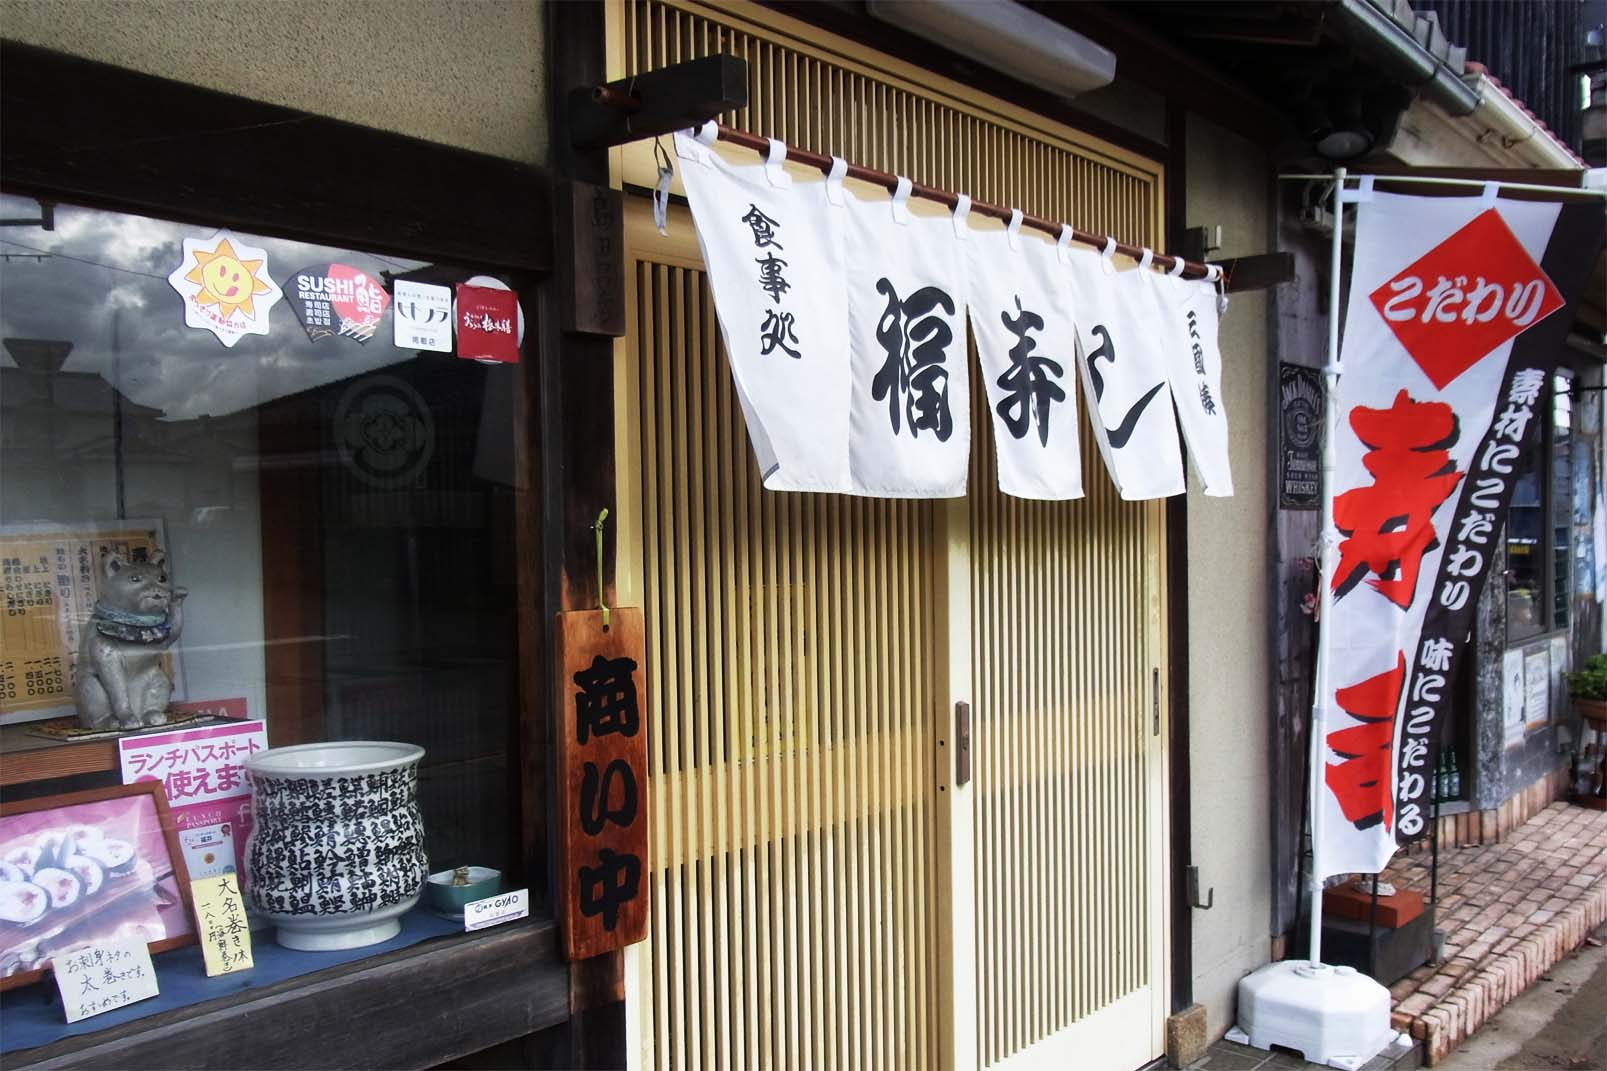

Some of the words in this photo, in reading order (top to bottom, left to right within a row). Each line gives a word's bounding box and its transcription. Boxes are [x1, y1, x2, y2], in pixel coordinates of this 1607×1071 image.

[297, 274, 355, 296] SUSHI
[298, 291, 355, 304] RESTAURANT
[741, 203, 802, 360] 食事処
[1383, 275, 1546, 327] こだわり
[1439, 367, 1546, 611] 素材にこだわり
[128, 738, 261, 774] ランチパスポート
[1398, 637, 1454, 836] 味にこだわる
[573, 655, 641, 932] 商い中
